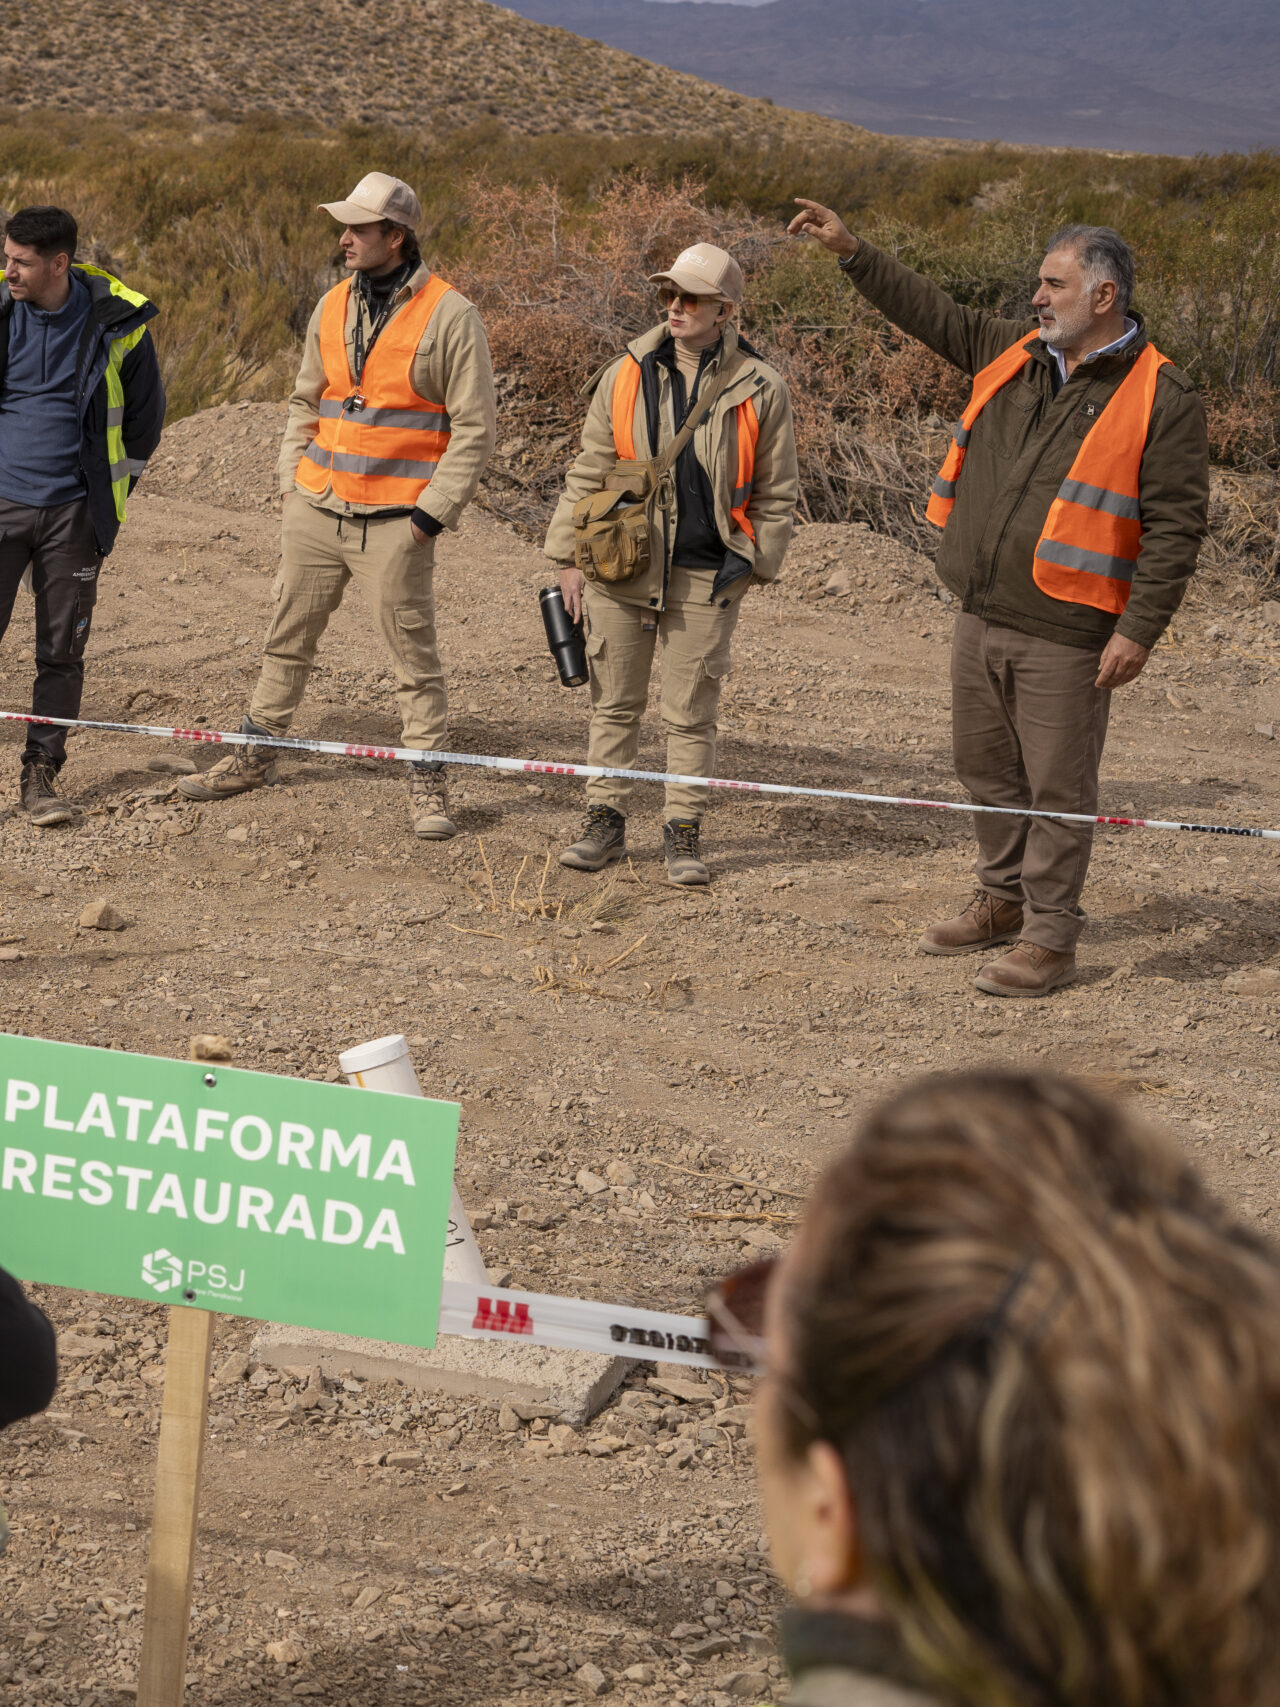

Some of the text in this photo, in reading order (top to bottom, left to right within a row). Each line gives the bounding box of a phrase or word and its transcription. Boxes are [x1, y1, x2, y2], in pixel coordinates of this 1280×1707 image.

[4, 1079, 416, 1186] PLATAFORMA
[1, 1147, 406, 1255] RESTAURADA
[187, 1260, 245, 1292] PSJ
